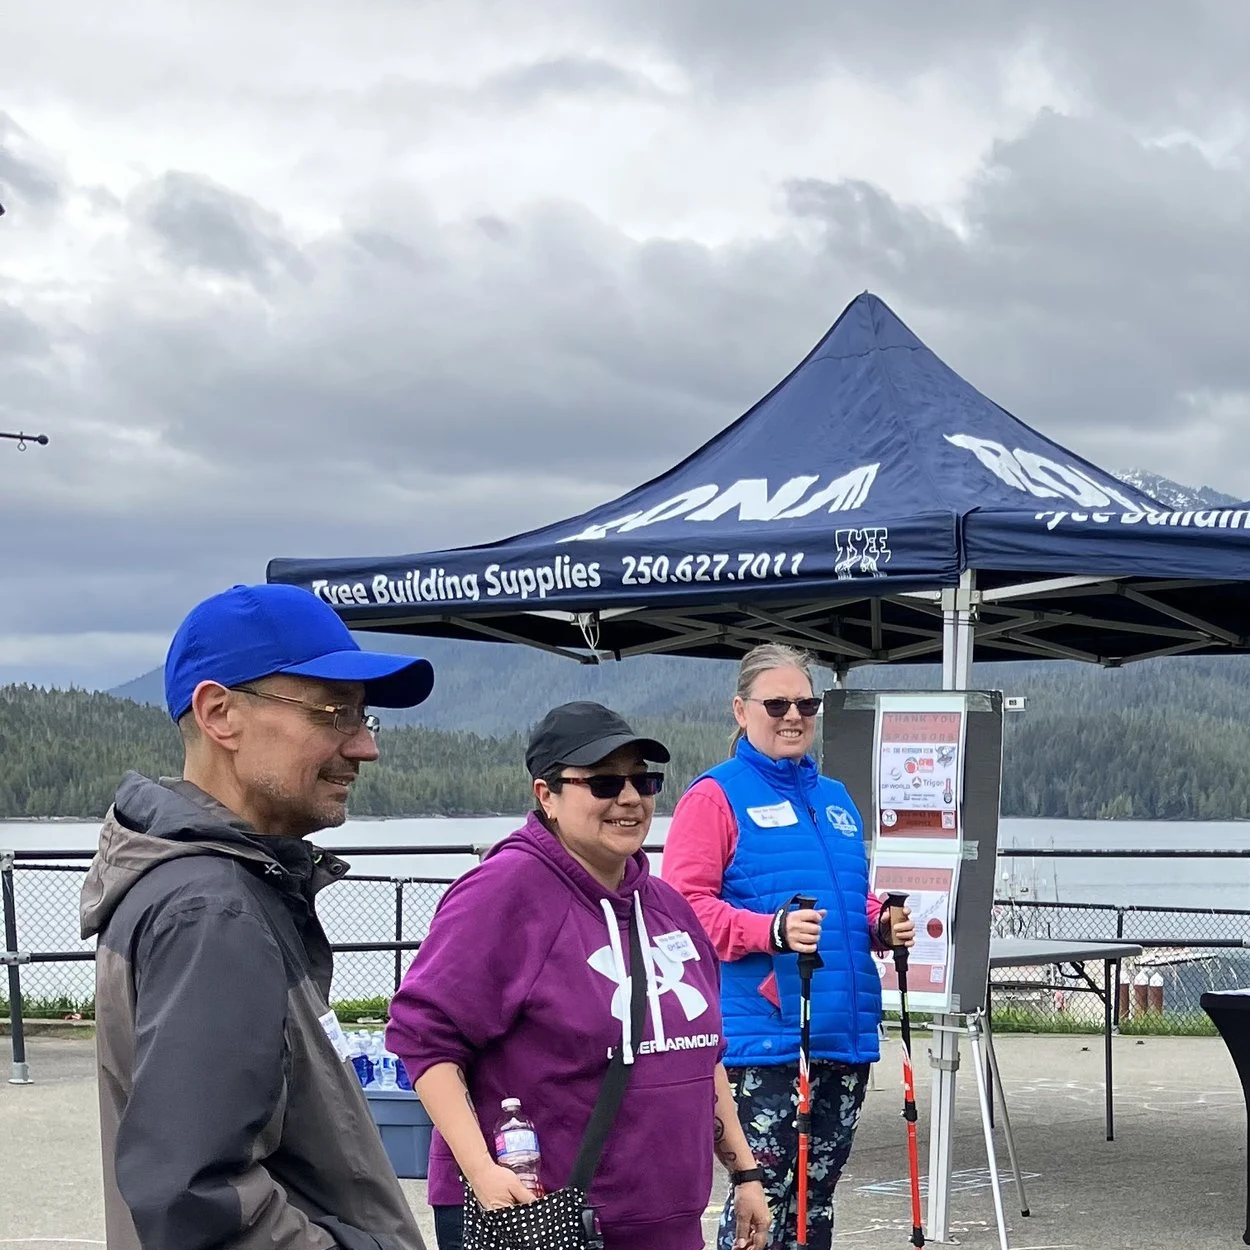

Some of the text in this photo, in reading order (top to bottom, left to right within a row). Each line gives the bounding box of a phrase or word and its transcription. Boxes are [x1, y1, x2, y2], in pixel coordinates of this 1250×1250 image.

[371, 567, 480, 605] Building
[484, 554, 601, 600] Supplies
[621, 552, 805, 586] 250.627.7011
[932, 714, 956, 723] YOU
[664, 1033, 719, 1052] ARMOUR
